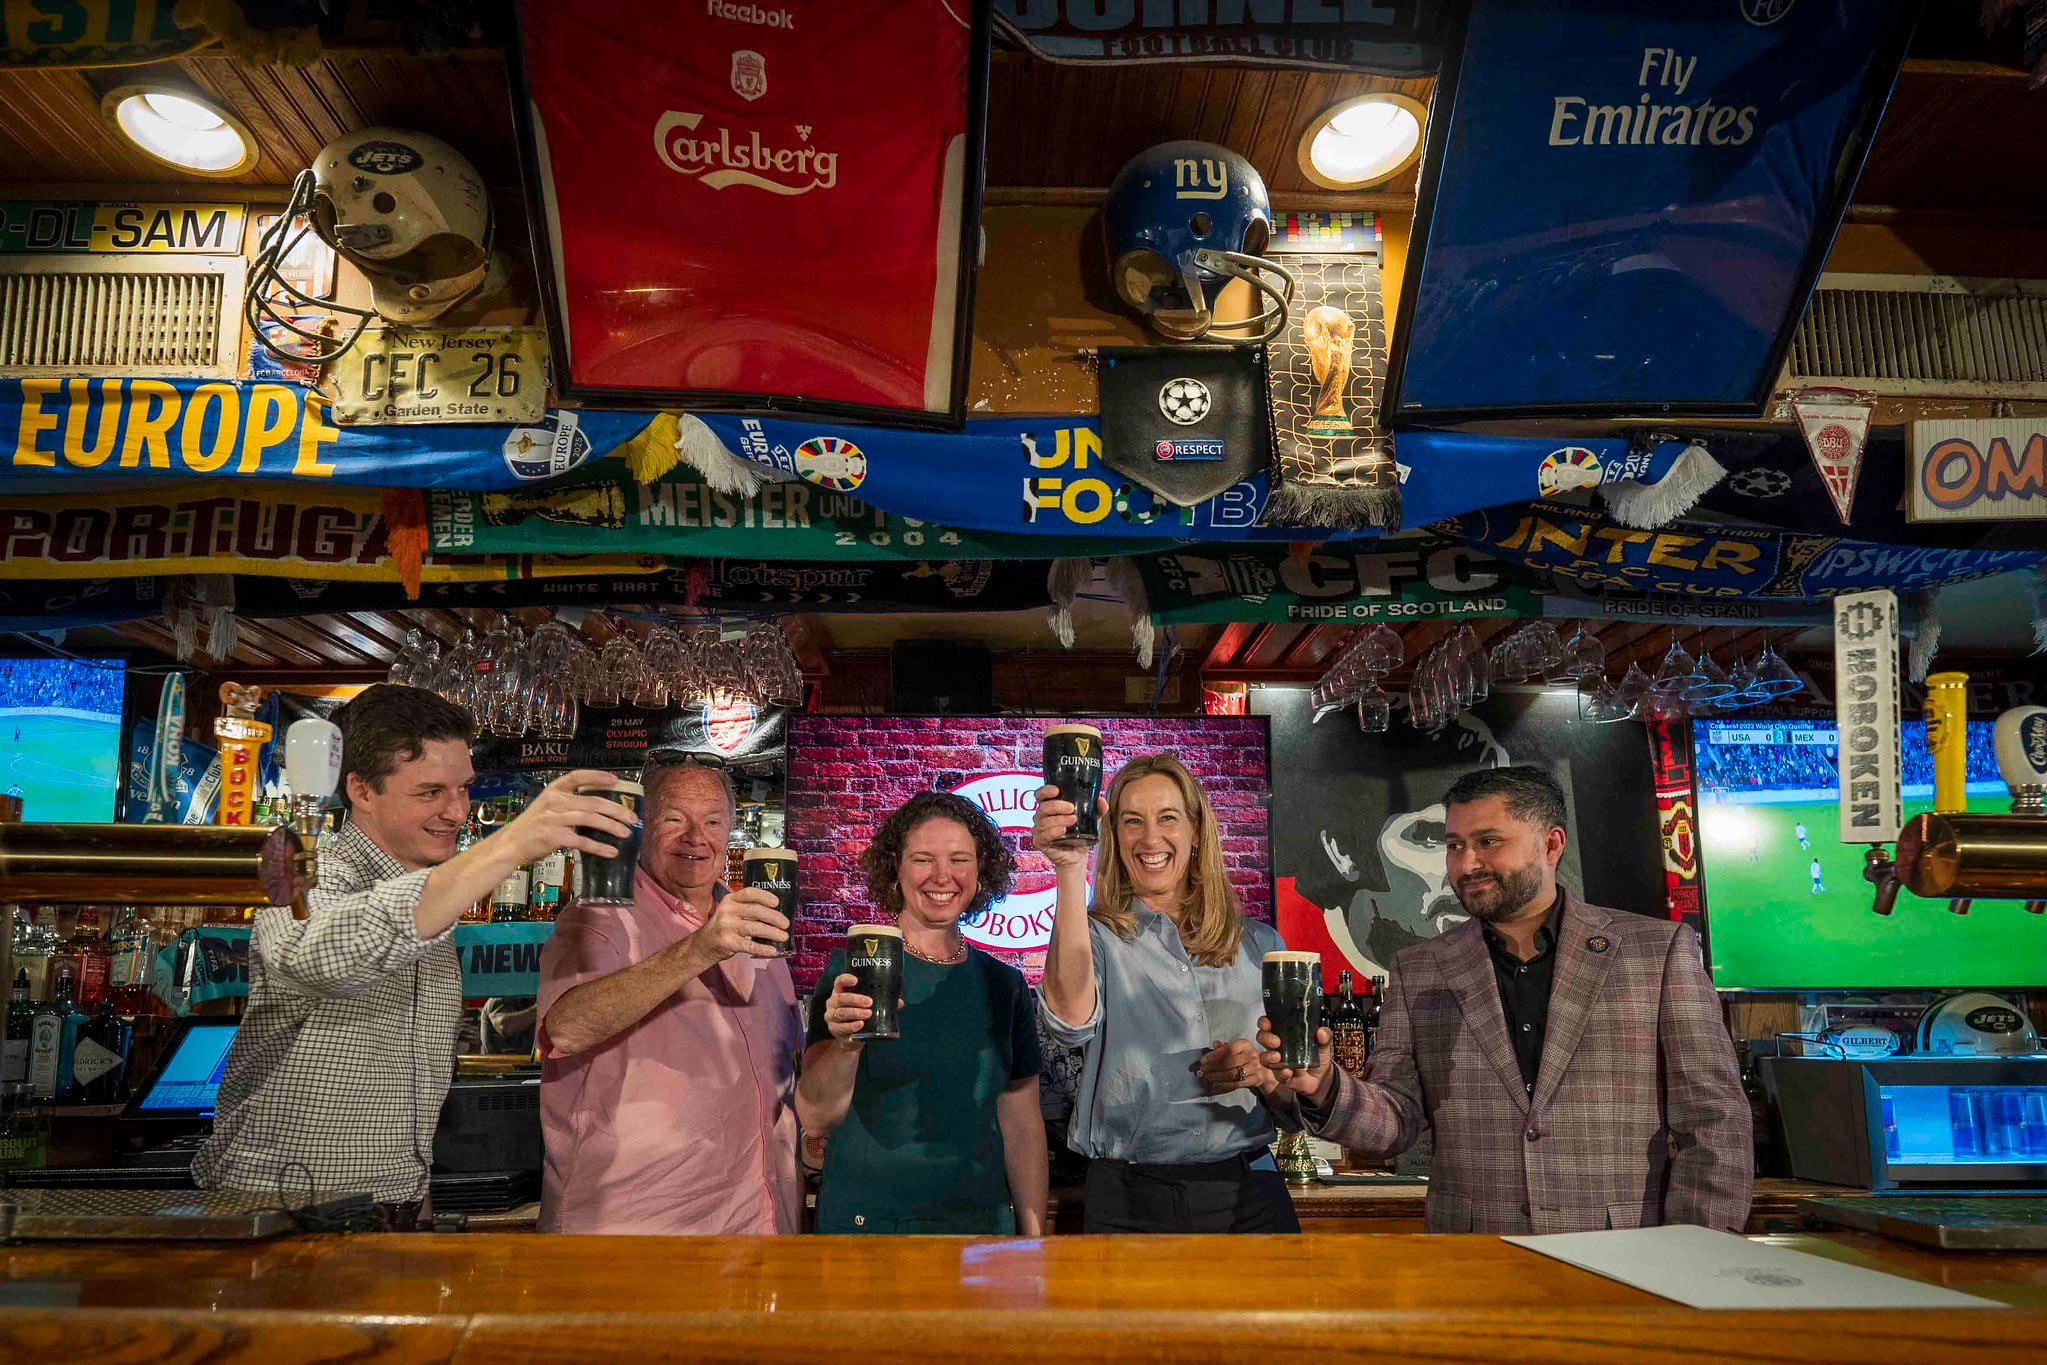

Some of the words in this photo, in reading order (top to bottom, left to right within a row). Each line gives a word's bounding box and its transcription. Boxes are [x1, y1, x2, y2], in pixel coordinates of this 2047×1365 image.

[706, 0, 794, 29] Reebok
[1639, 48, 1697, 95] Fly
[1549, 95, 1758, 146] Emirates
[654, 110, 838, 195] Carlsberg
[0, 206, 228, 250] -DL-SAM
[391, 334, 438, 348] New
[439, 335, 496, 351] Jersey
[361, 352, 440, 400] CFC
[467, 352, 522, 397] 26
[384, 403, 440, 417] Garden
[446, 402, 490, 415] State
[13, 377, 340, 477] EUROPE
[555, 424, 573, 472] EUROPE
[573, 437, 583, 457] 2025
[1175, 445, 1223, 455] RESPECT
[638, 482, 810, 529] MEISTER
[820, 496, 866, 519] UND
[1528, 500, 1603, 521] MILANO
[835, 531, 962, 546] 2004
[1496, 514, 1762, 576] INTER
[1278, 545, 1503, 597] CFC
[1808, 548, 1966, 580] IPSWICH
[543, 582, 598, 593] WHITE
[612, 582, 660, 593] HART
[674, 582, 722, 598] LE
[1655, 581, 1744, 597] CUP
[1288, 605, 1346, 619] PRIDE
[1352, 604, 1382, 618] OF
[1387, 598, 1508, 617] SCOTLAND
[1604, 601, 1663, 616] PRIDE
[1669, 602, 1695, 616] OF
[1701, 603, 1762, 619] SPAIN
[611, 719, 622, 727] 29
[624, 718, 644, 726] MAY
[1775, 723, 1788, 731] Cup
[1789, 723, 1815, 731] Qualifier
[606, 729, 648, 738] OLYMPIC
[1732, 734, 1751, 742] USA
[1765, 733, 1772, 742] 0
[1795, 733, 1815, 742] MEX
[1828, 733, 1835, 742] 0
[1846, 648, 1882, 827] HOBOKEN
[521, 742, 570, 757] BAKU
[605, 740, 648, 749] STADIUM
[520, 757, 545, 765] FINAL
[1060, 755, 1101, 768] GUINNESS
[205, 763, 222, 785] Club
[226, 747, 250, 825] BOCK
[751, 879, 791, 890] GUINNESS
[851, 957, 892, 968] GUINNESS
[1974, 1013, 2016, 1025] JETS
[1842, 1036, 1888, 1046] GILBERT
[0, 1136, 38, 1149] SOLUT
